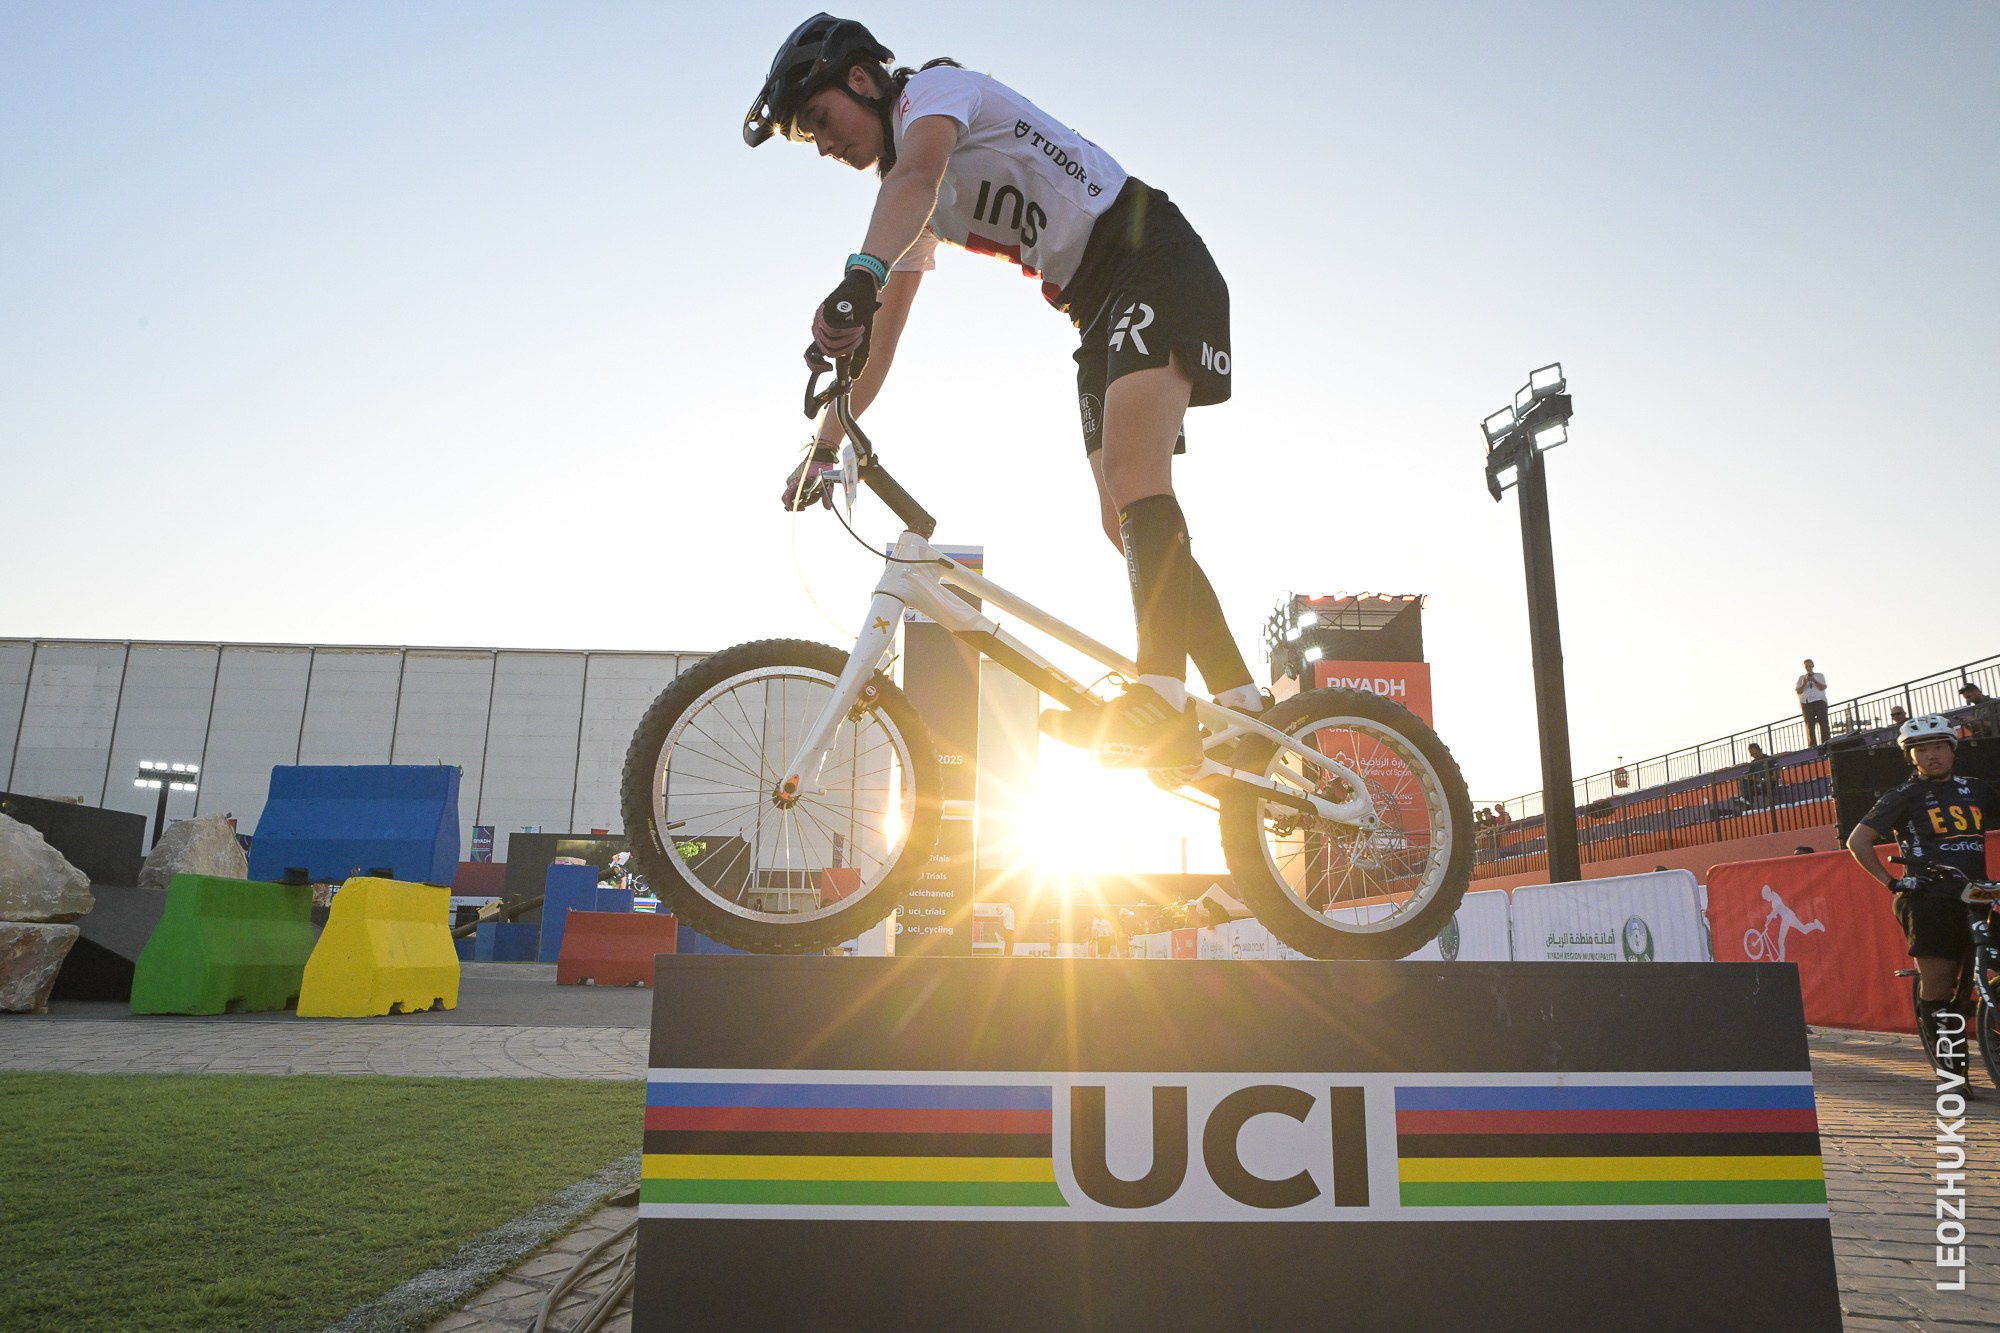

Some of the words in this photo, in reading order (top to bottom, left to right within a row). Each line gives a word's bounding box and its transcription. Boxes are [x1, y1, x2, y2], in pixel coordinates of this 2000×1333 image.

[1030, 131, 1087, 184] TUDOR
[938, 754, 963, 765] 2025
[1927, 804, 1982, 834] ESP
[926, 872, 947, 880] Trials
[908, 907, 946, 917] uci_trials
[907, 926, 954, 936] uci_cycling
[1070, 1084, 1370, 1209] UCI
